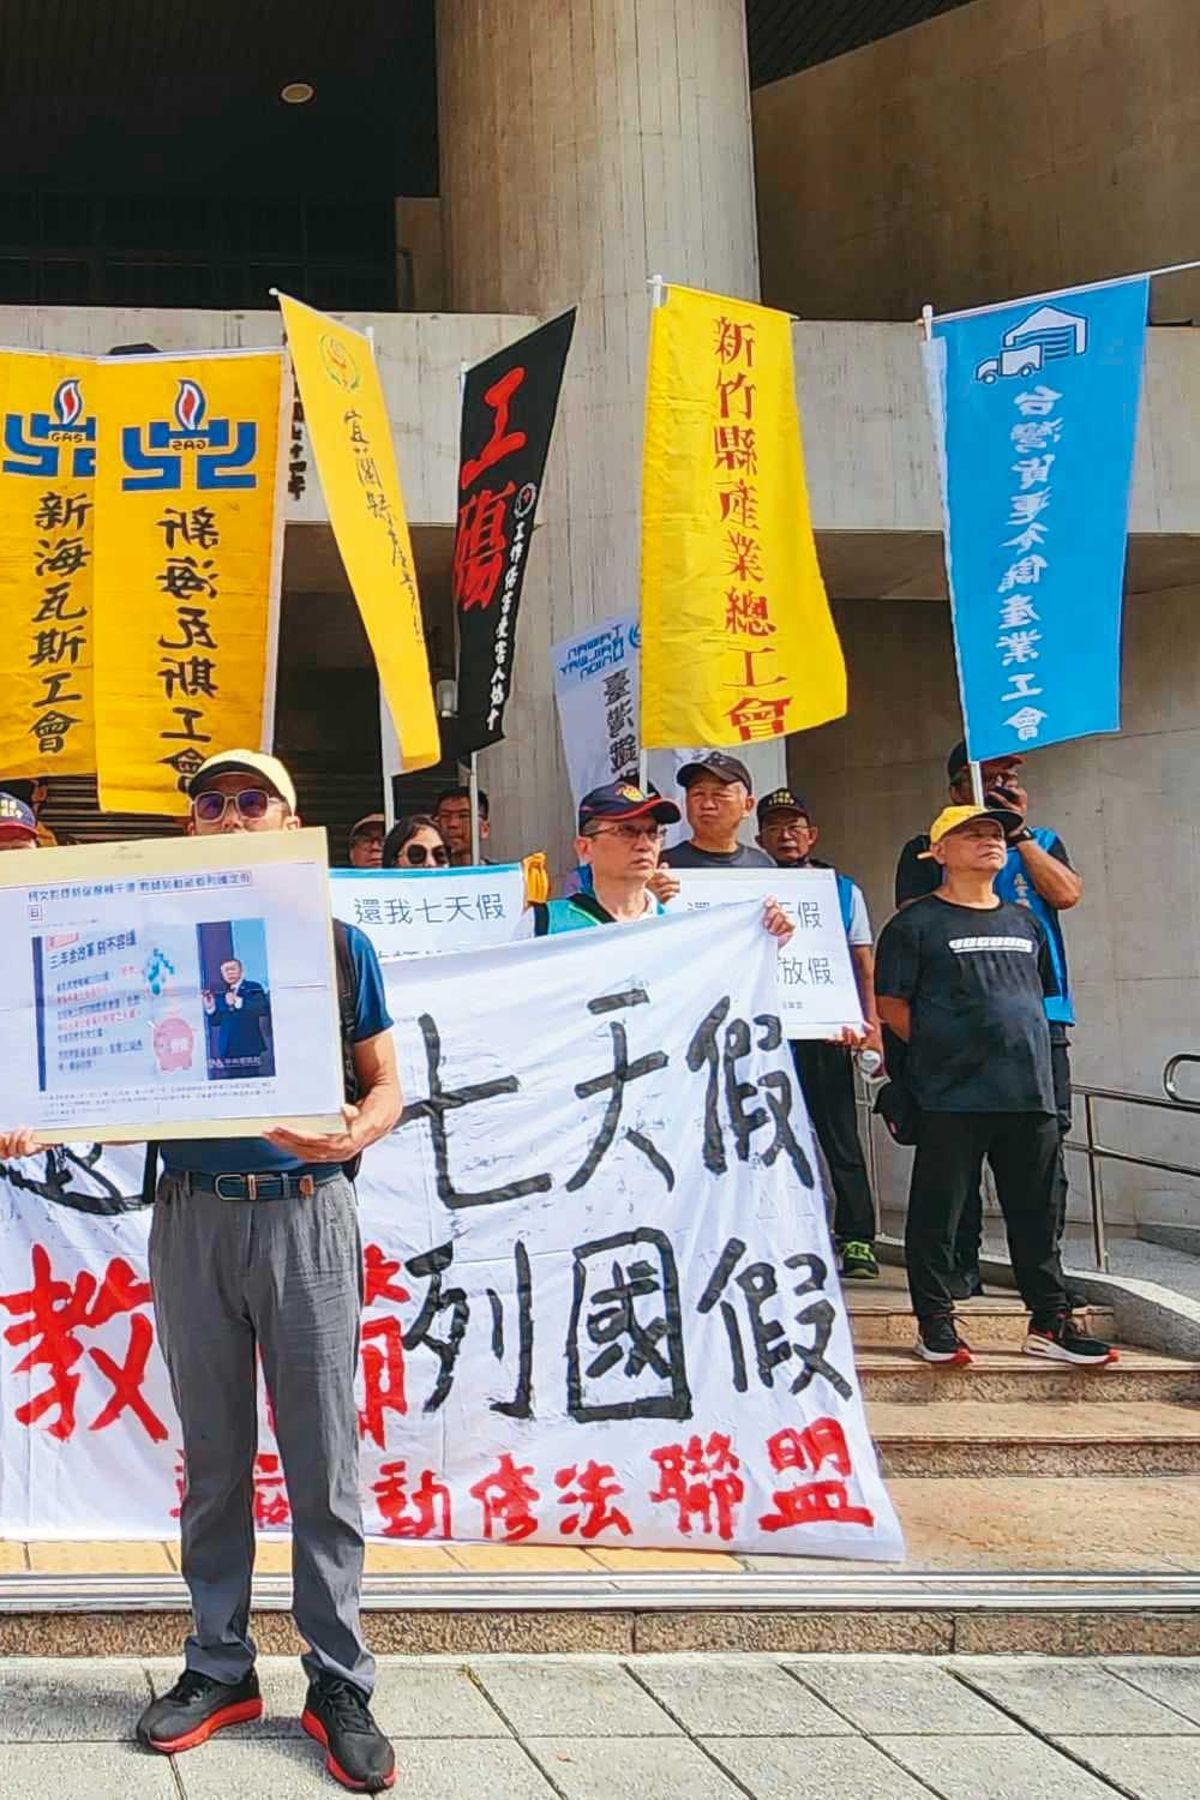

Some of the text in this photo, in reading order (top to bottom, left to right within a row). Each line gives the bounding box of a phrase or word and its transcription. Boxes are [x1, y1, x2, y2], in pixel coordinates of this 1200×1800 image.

[50, 432, 85, 443] GAS
[713, 316, 793, 742] 新竹縣產業總工會
[29, 491, 94, 754] 新海瓦斯工會
[354, 893, 506, 925] 還我七天假
[160, 1416, 876, 1542] 動修法聯盟
